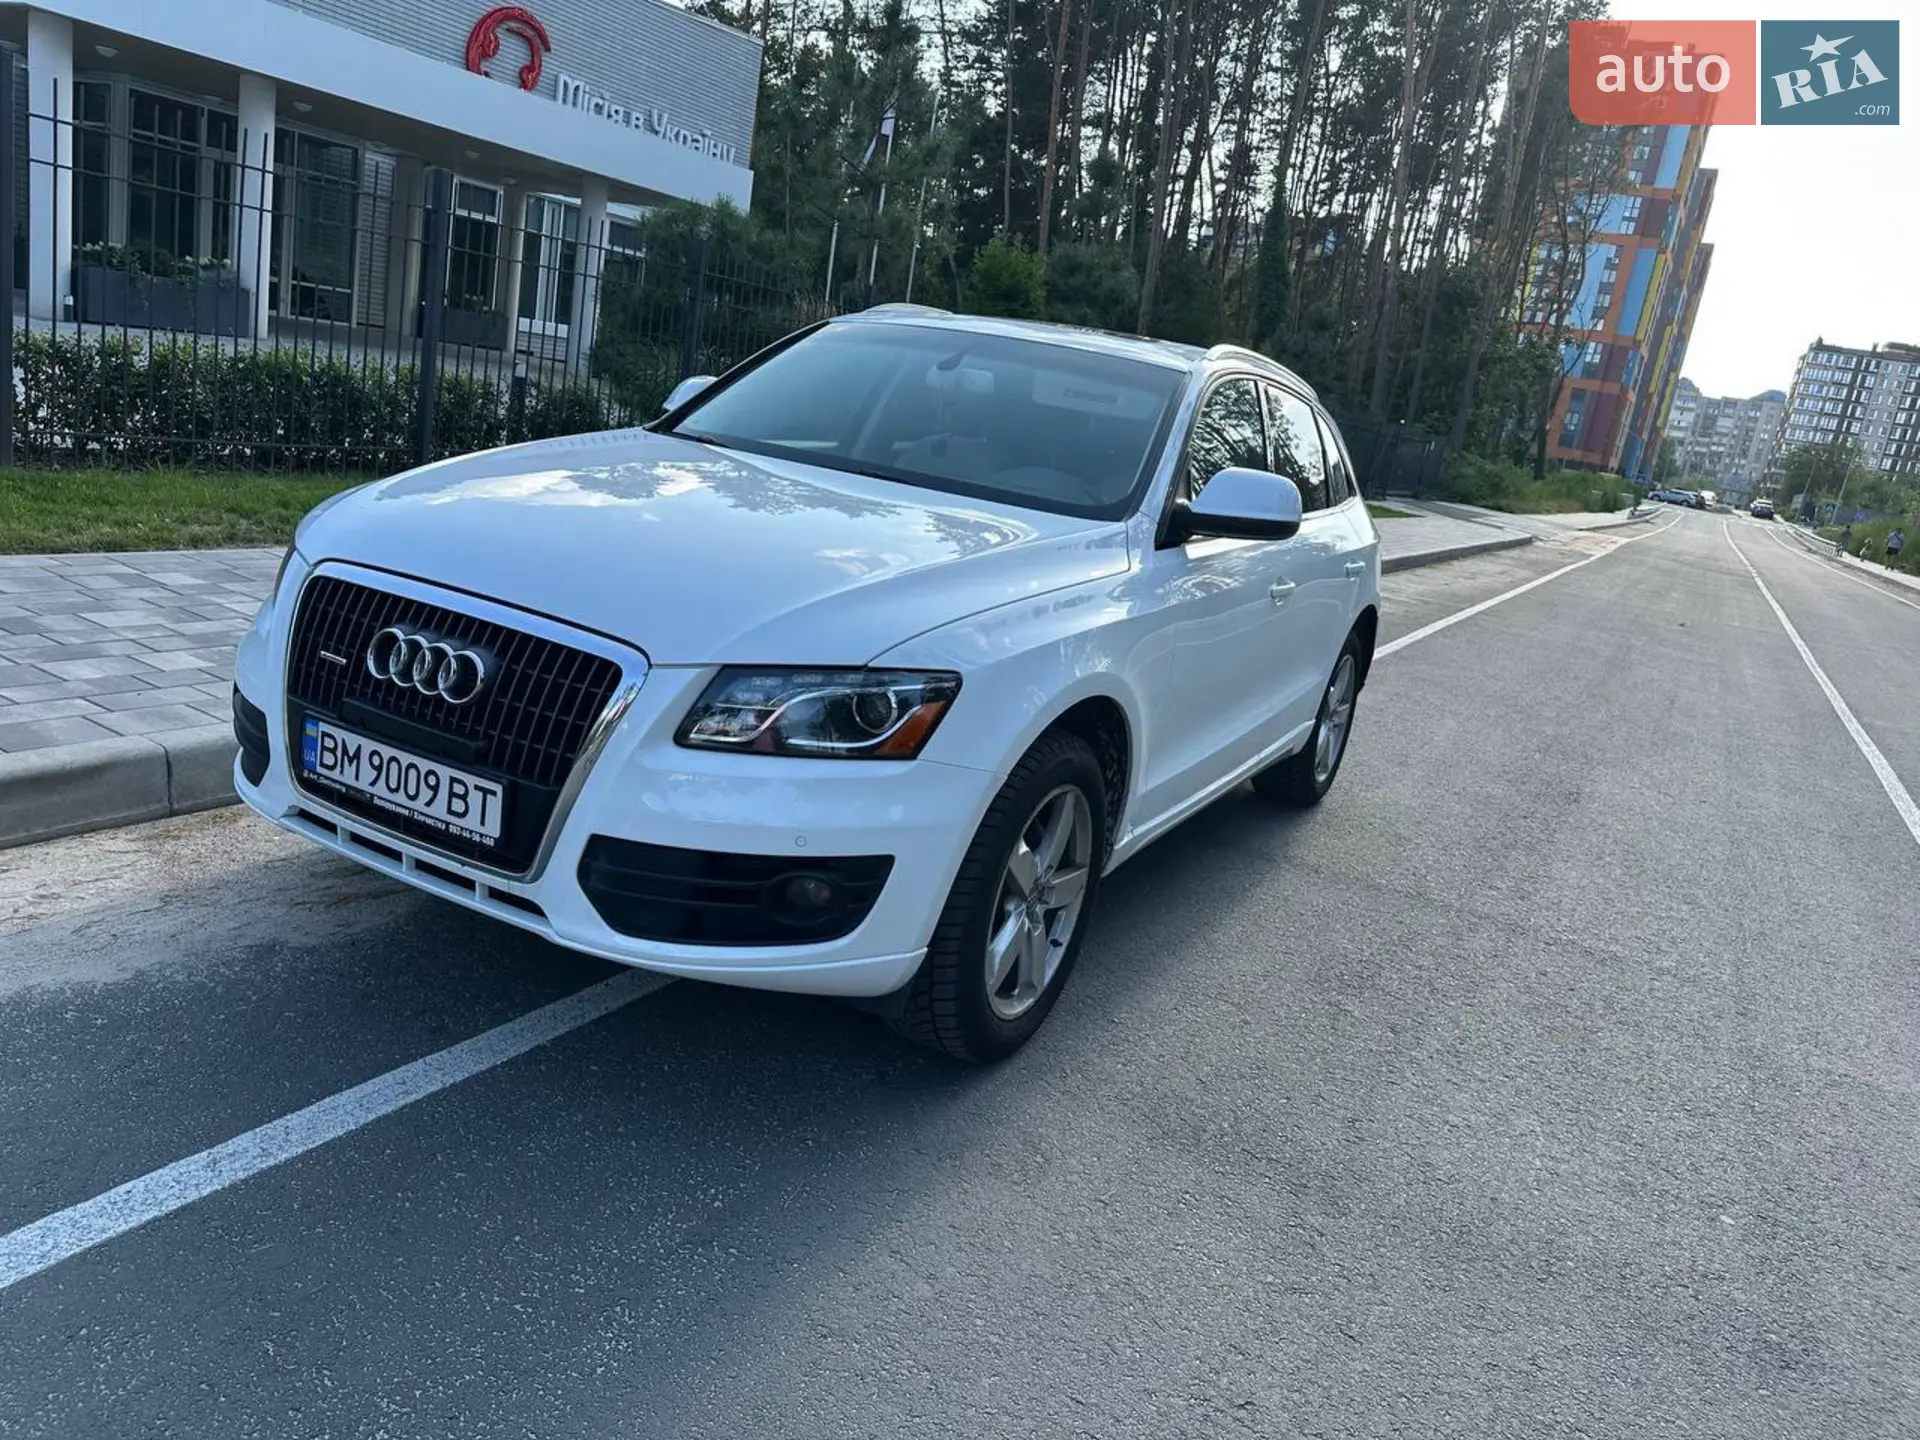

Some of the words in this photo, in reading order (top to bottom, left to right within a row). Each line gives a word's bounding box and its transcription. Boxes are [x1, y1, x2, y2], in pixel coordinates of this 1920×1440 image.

[319, 730, 362, 782] BM
[368, 749, 441, 808] 9009
[446, 774, 498, 828] BT
